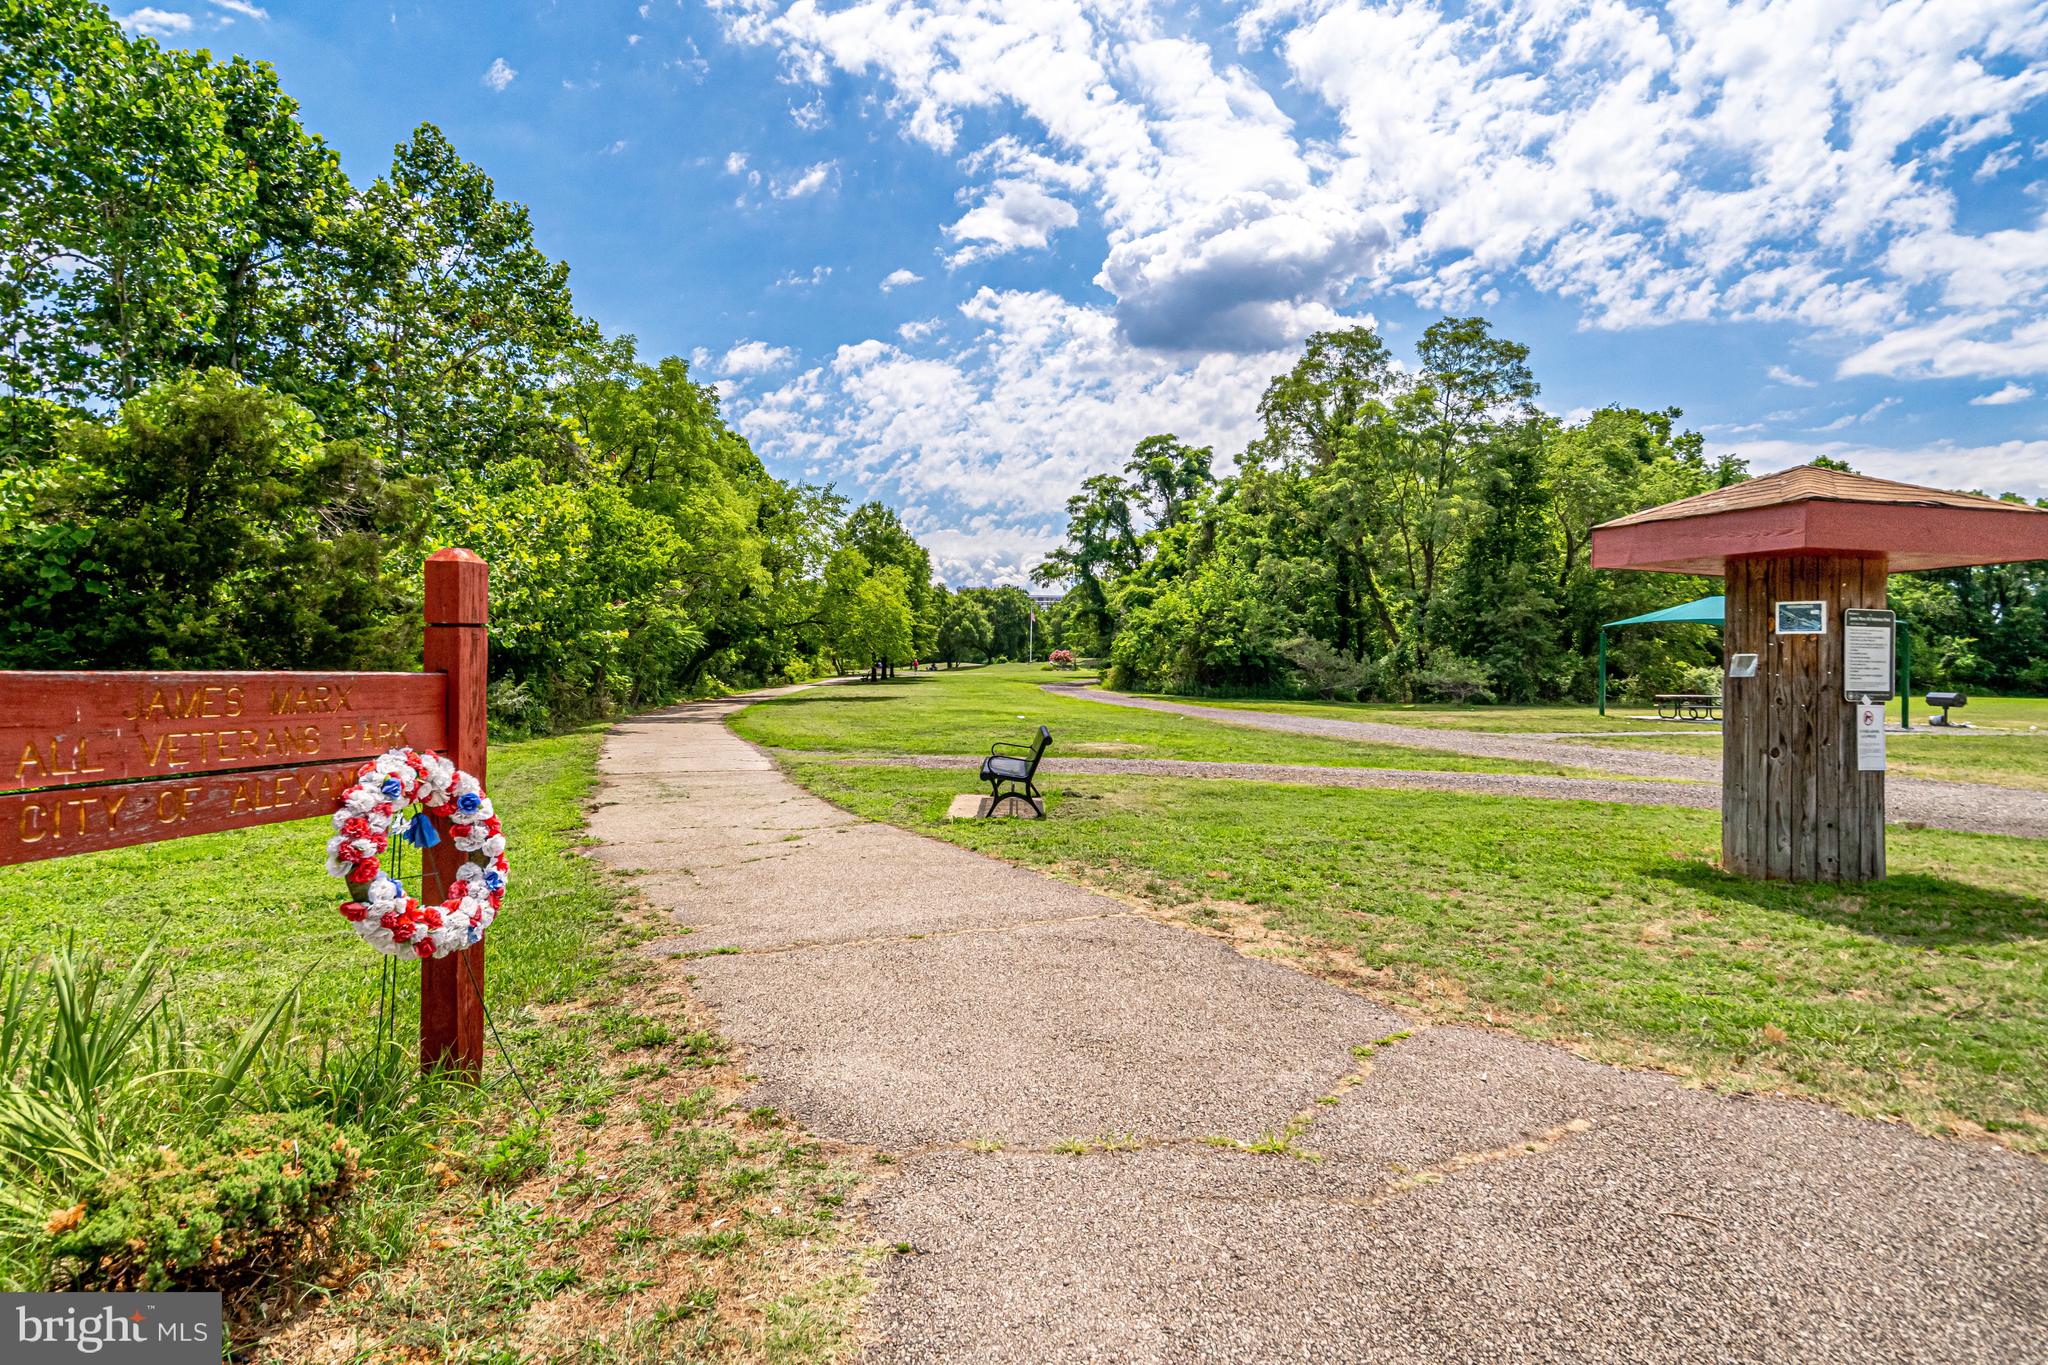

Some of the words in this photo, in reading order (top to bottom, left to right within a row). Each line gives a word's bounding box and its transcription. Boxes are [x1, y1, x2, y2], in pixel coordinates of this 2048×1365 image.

[122, 687, 245, 720] JAMES
[269, 686, 353, 715] MARX
[15, 737, 105, 779] ALL
[138, 726, 321, 767] VETERANS
[340, 721, 409, 751] PARK
[20, 795, 126, 843] CITY
[158, 787, 202, 824] OF
